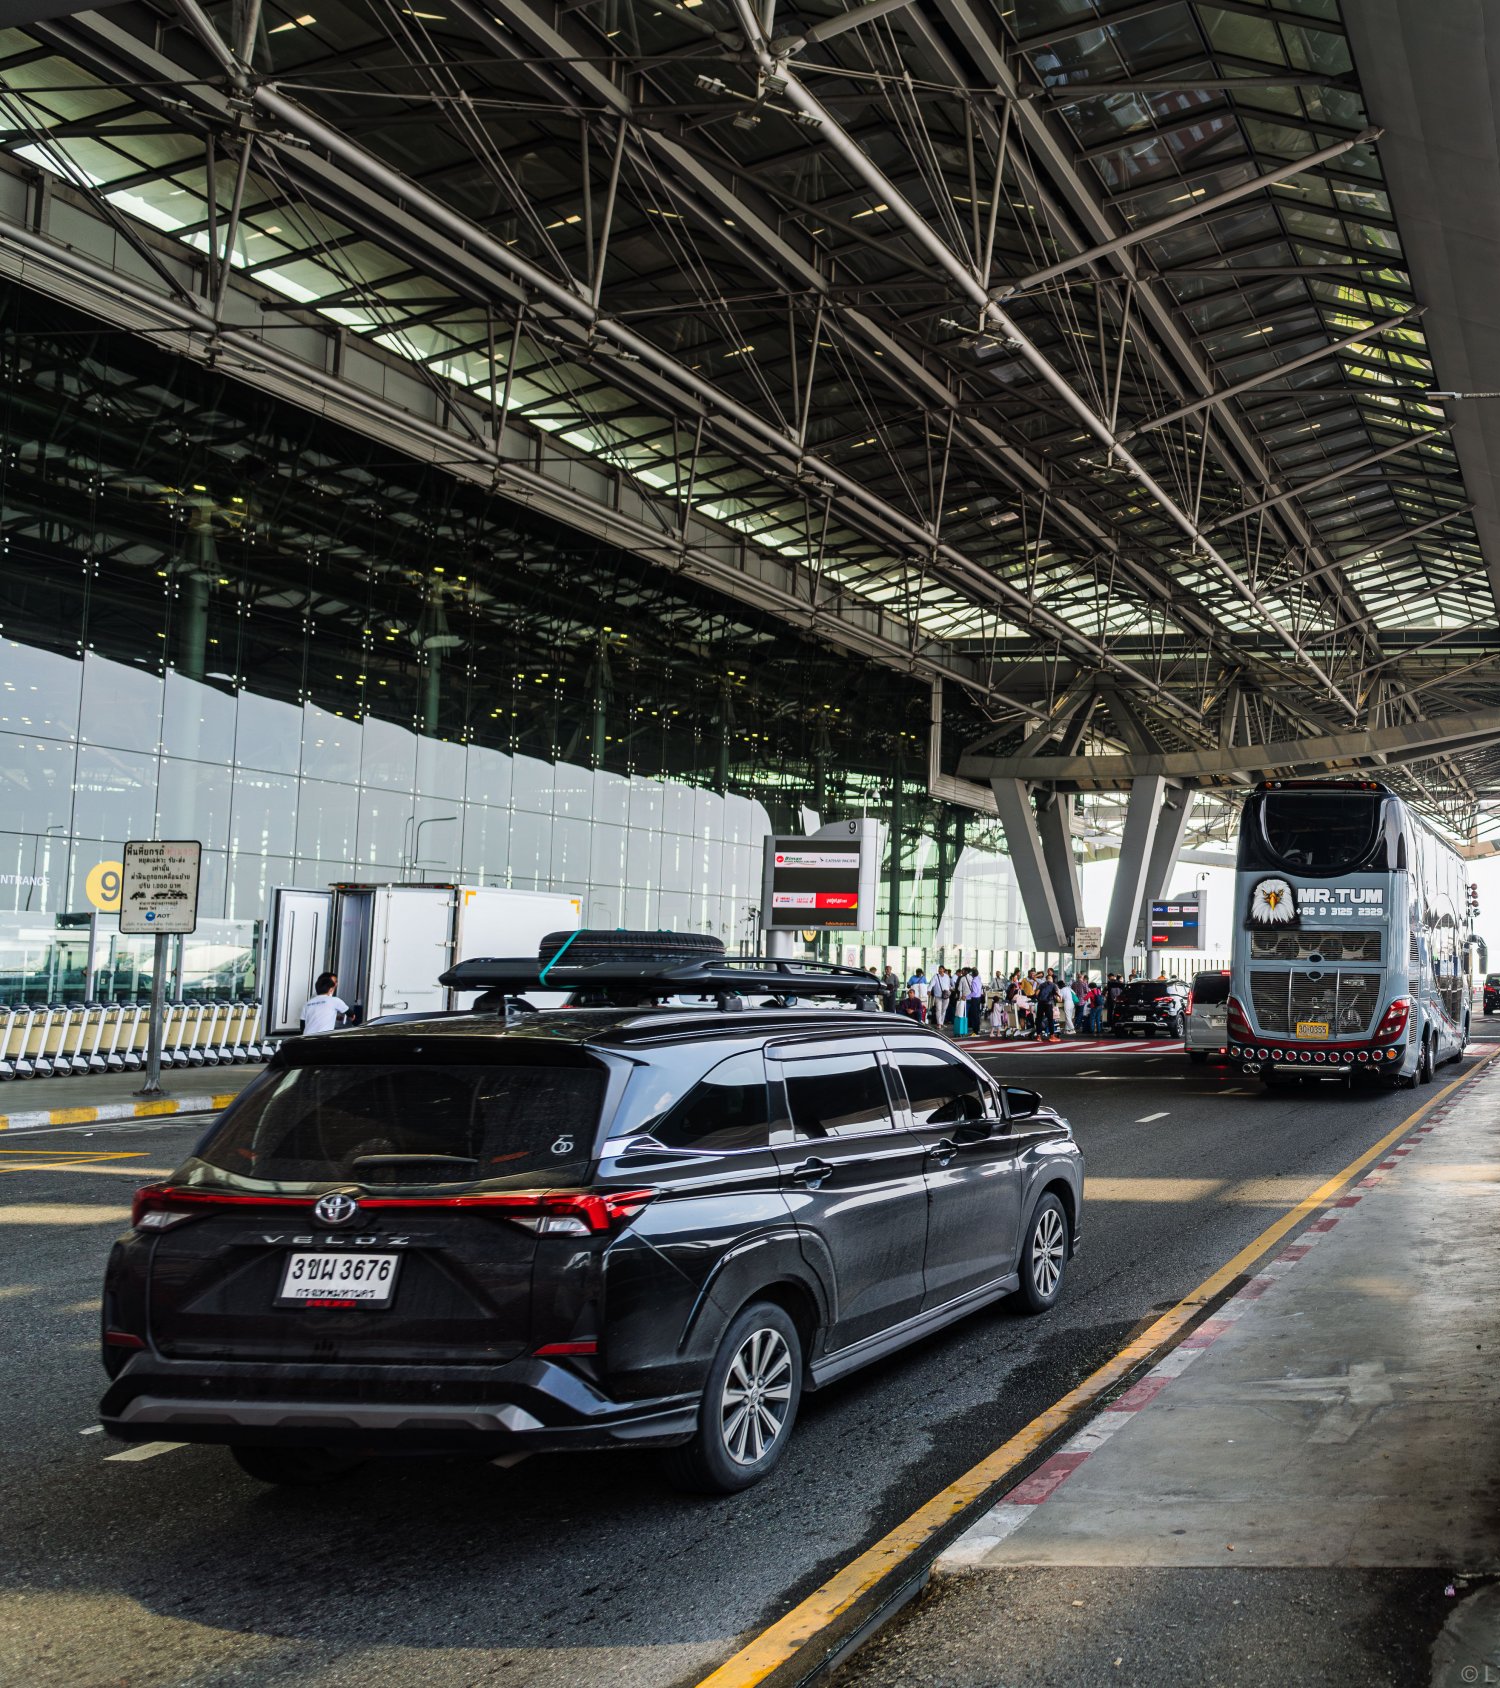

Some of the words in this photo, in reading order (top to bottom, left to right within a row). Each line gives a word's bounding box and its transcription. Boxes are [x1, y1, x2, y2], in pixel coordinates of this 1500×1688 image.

[849, 821, 857, 834] 9
[101, 871, 120, 901] 9
[1297, 888, 1383, 904] MR.TUM
[1320, 907, 1326, 915] 9
[1331, 907, 1352, 916] 3125
[1358, 907, 1383, 916] 2329
[262, 1235, 410, 1245] VELOZ
[340, 1259, 391, 1281] 3676
